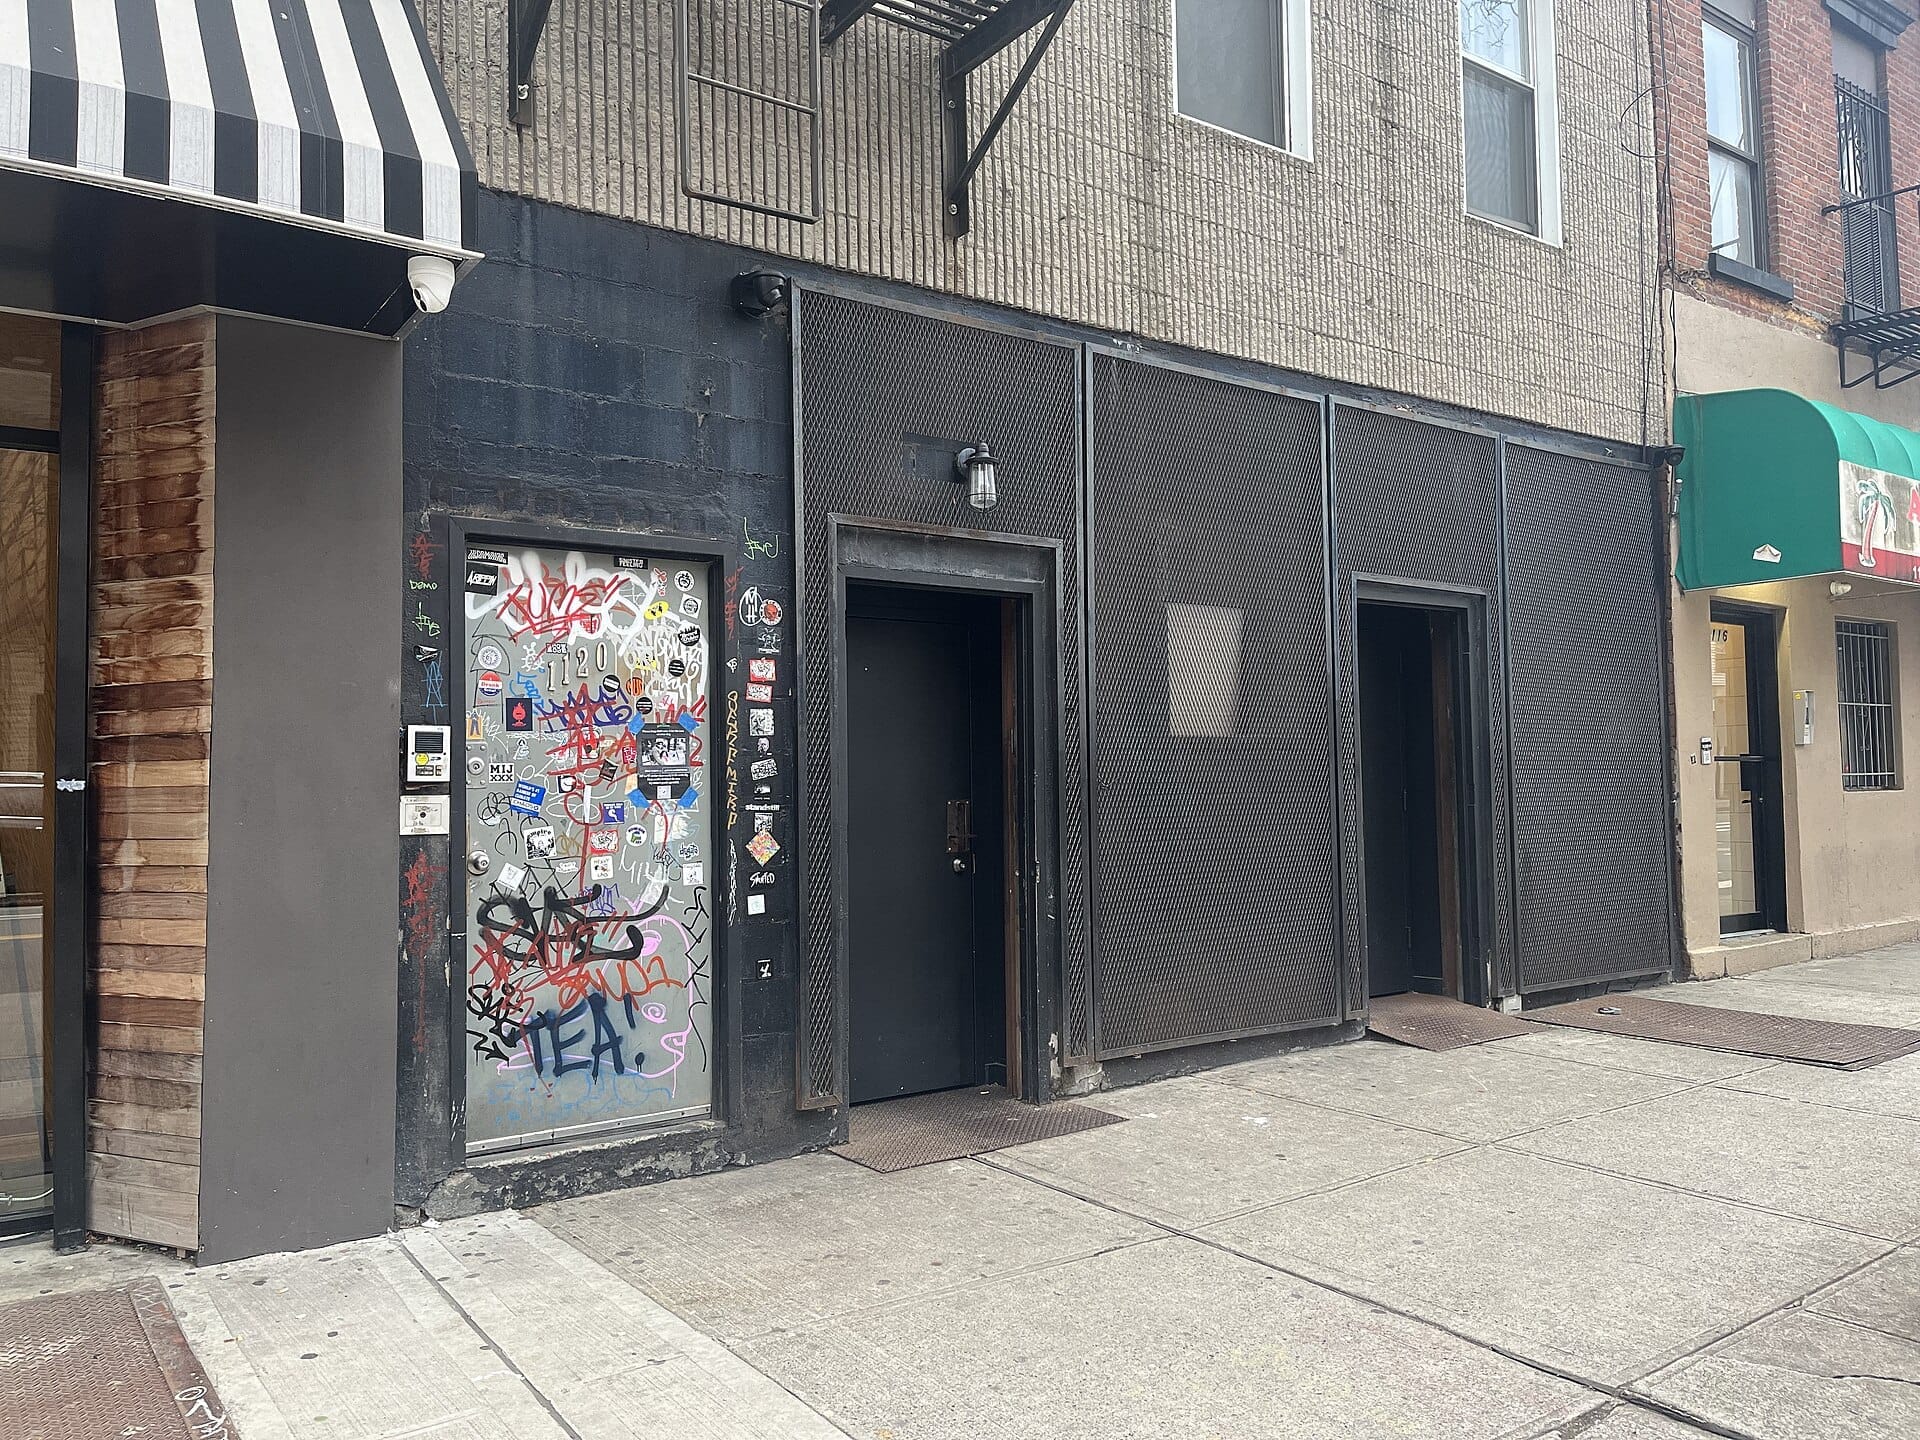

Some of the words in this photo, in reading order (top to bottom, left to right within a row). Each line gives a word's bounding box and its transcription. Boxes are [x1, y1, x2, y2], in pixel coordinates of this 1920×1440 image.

[1711, 629, 1728, 642] 116
[546, 641, 607, 692] 1120
[490, 764, 513, 773] MIJ
[490, 774, 513, 782] XXX
[745, 803, 780, 812] standstill
